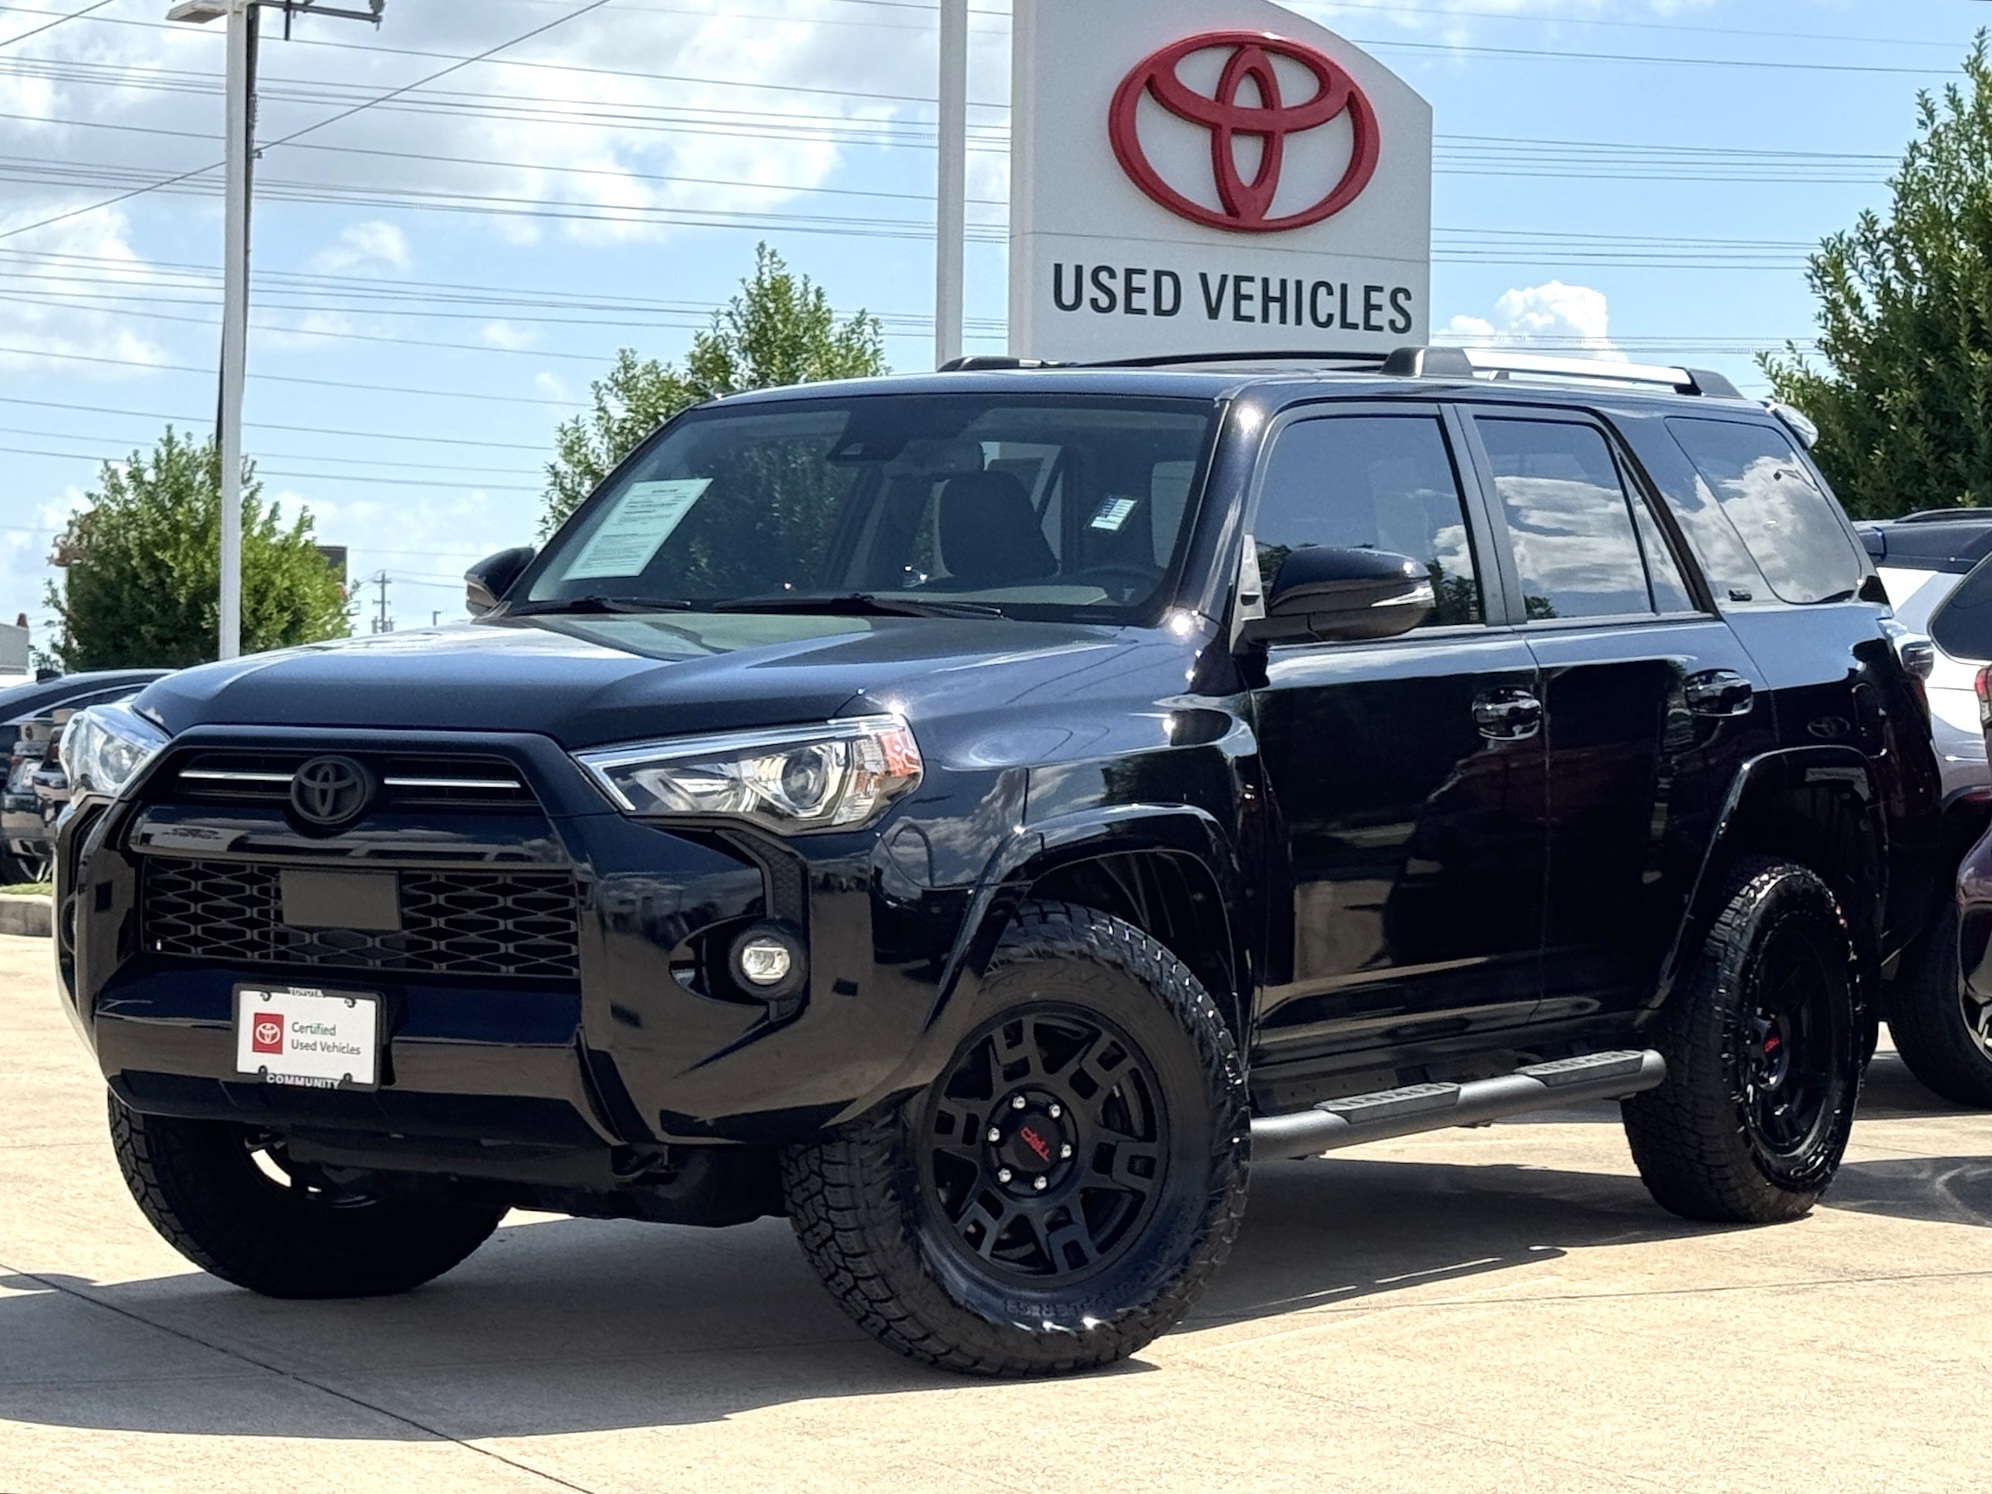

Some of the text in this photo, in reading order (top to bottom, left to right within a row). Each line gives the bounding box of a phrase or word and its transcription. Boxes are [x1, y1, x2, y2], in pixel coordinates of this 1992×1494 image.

[1053, 263, 1413, 334] USED VEHICLES
[292, 1022, 337, 1037] Certified
[292, 1039, 361, 1056] Used Vehicles
[266, 1074, 341, 1090] COMMUNITY
